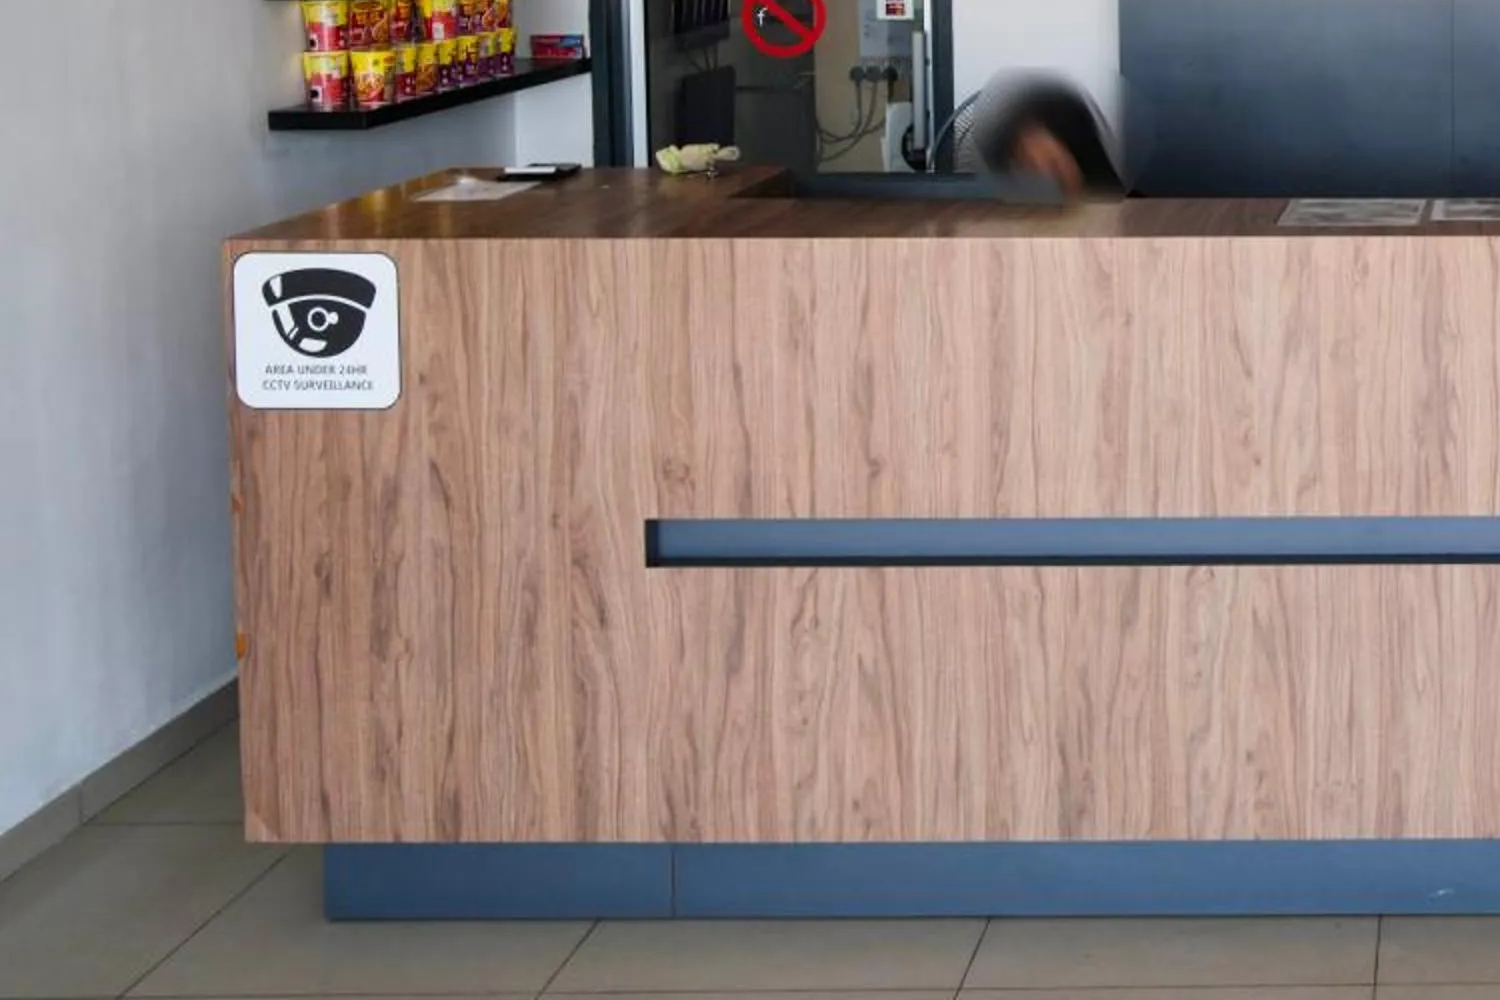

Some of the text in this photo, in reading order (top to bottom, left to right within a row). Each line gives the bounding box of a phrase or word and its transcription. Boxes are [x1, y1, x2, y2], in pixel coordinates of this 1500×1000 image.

[265, 365, 295, 375] AREA
[297, 365, 336, 375] UNDER
[262, 379, 292, 391] CCTV
